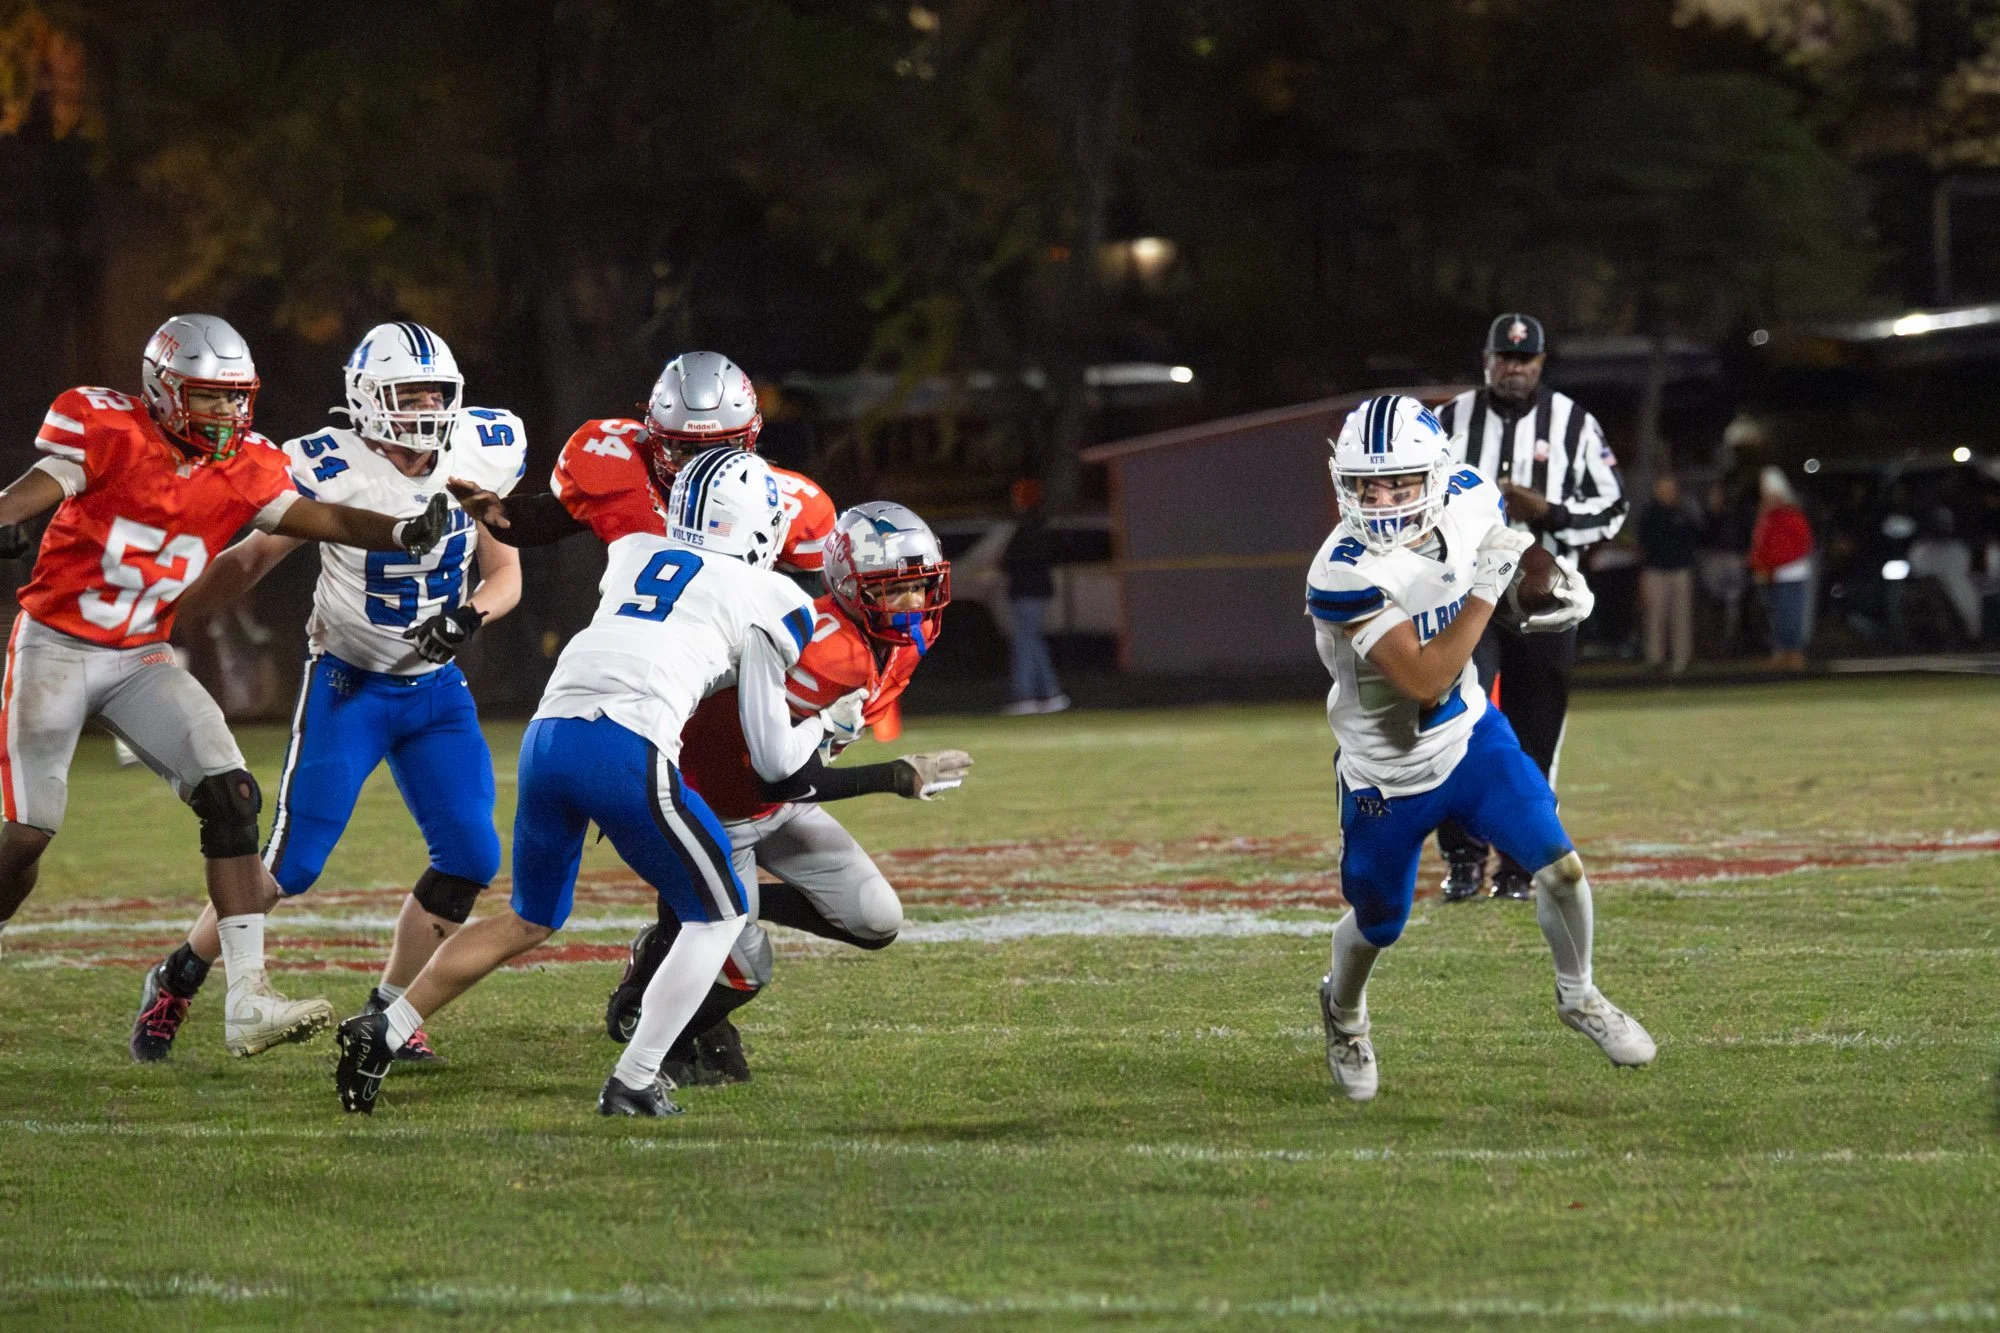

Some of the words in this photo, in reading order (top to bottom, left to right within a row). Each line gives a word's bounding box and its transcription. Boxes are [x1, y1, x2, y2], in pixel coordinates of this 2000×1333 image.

[582, 418, 650, 462] 54
[687, 423, 717, 431] Riddell
[300, 433, 350, 483] 54
[1447, 469, 1484, 496] 2
[1328, 536, 1368, 567] 2
[78, 514, 210, 638] 52
[364, 532, 468, 629] 54
[614, 549, 704, 622] 9
